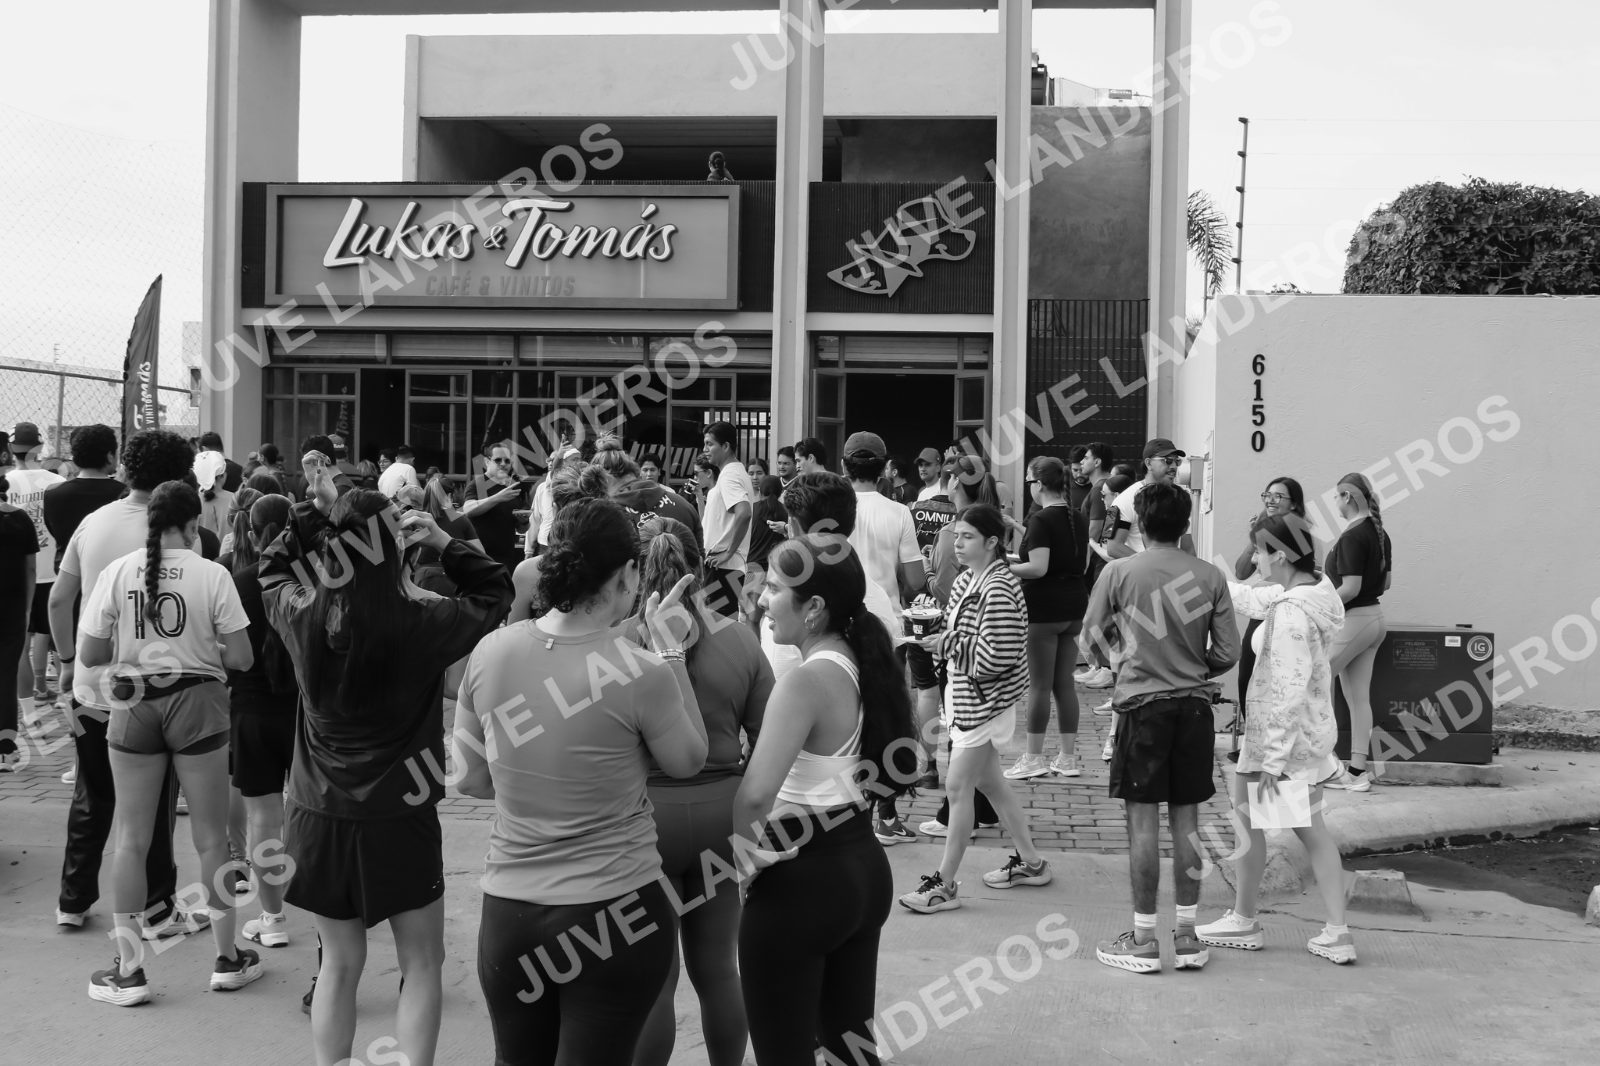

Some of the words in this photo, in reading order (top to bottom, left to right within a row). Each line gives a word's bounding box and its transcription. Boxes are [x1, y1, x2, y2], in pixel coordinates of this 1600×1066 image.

[324, 198, 476, 267] Lukas
[483, 225, 504, 248] &
[502, 198, 678, 268] Tomás
[425, 270, 471, 296] CAFÉ
[478, 276, 491, 296] &
[501, 275, 576, 297] VINITOS
[1251, 354, 1265, 452] 6150
[916, 511, 956, 523] OMNIL
[136, 566, 184, 580] MSSI
[128, 590, 187, 639] 10
[1474, 642, 1486, 652] IG
